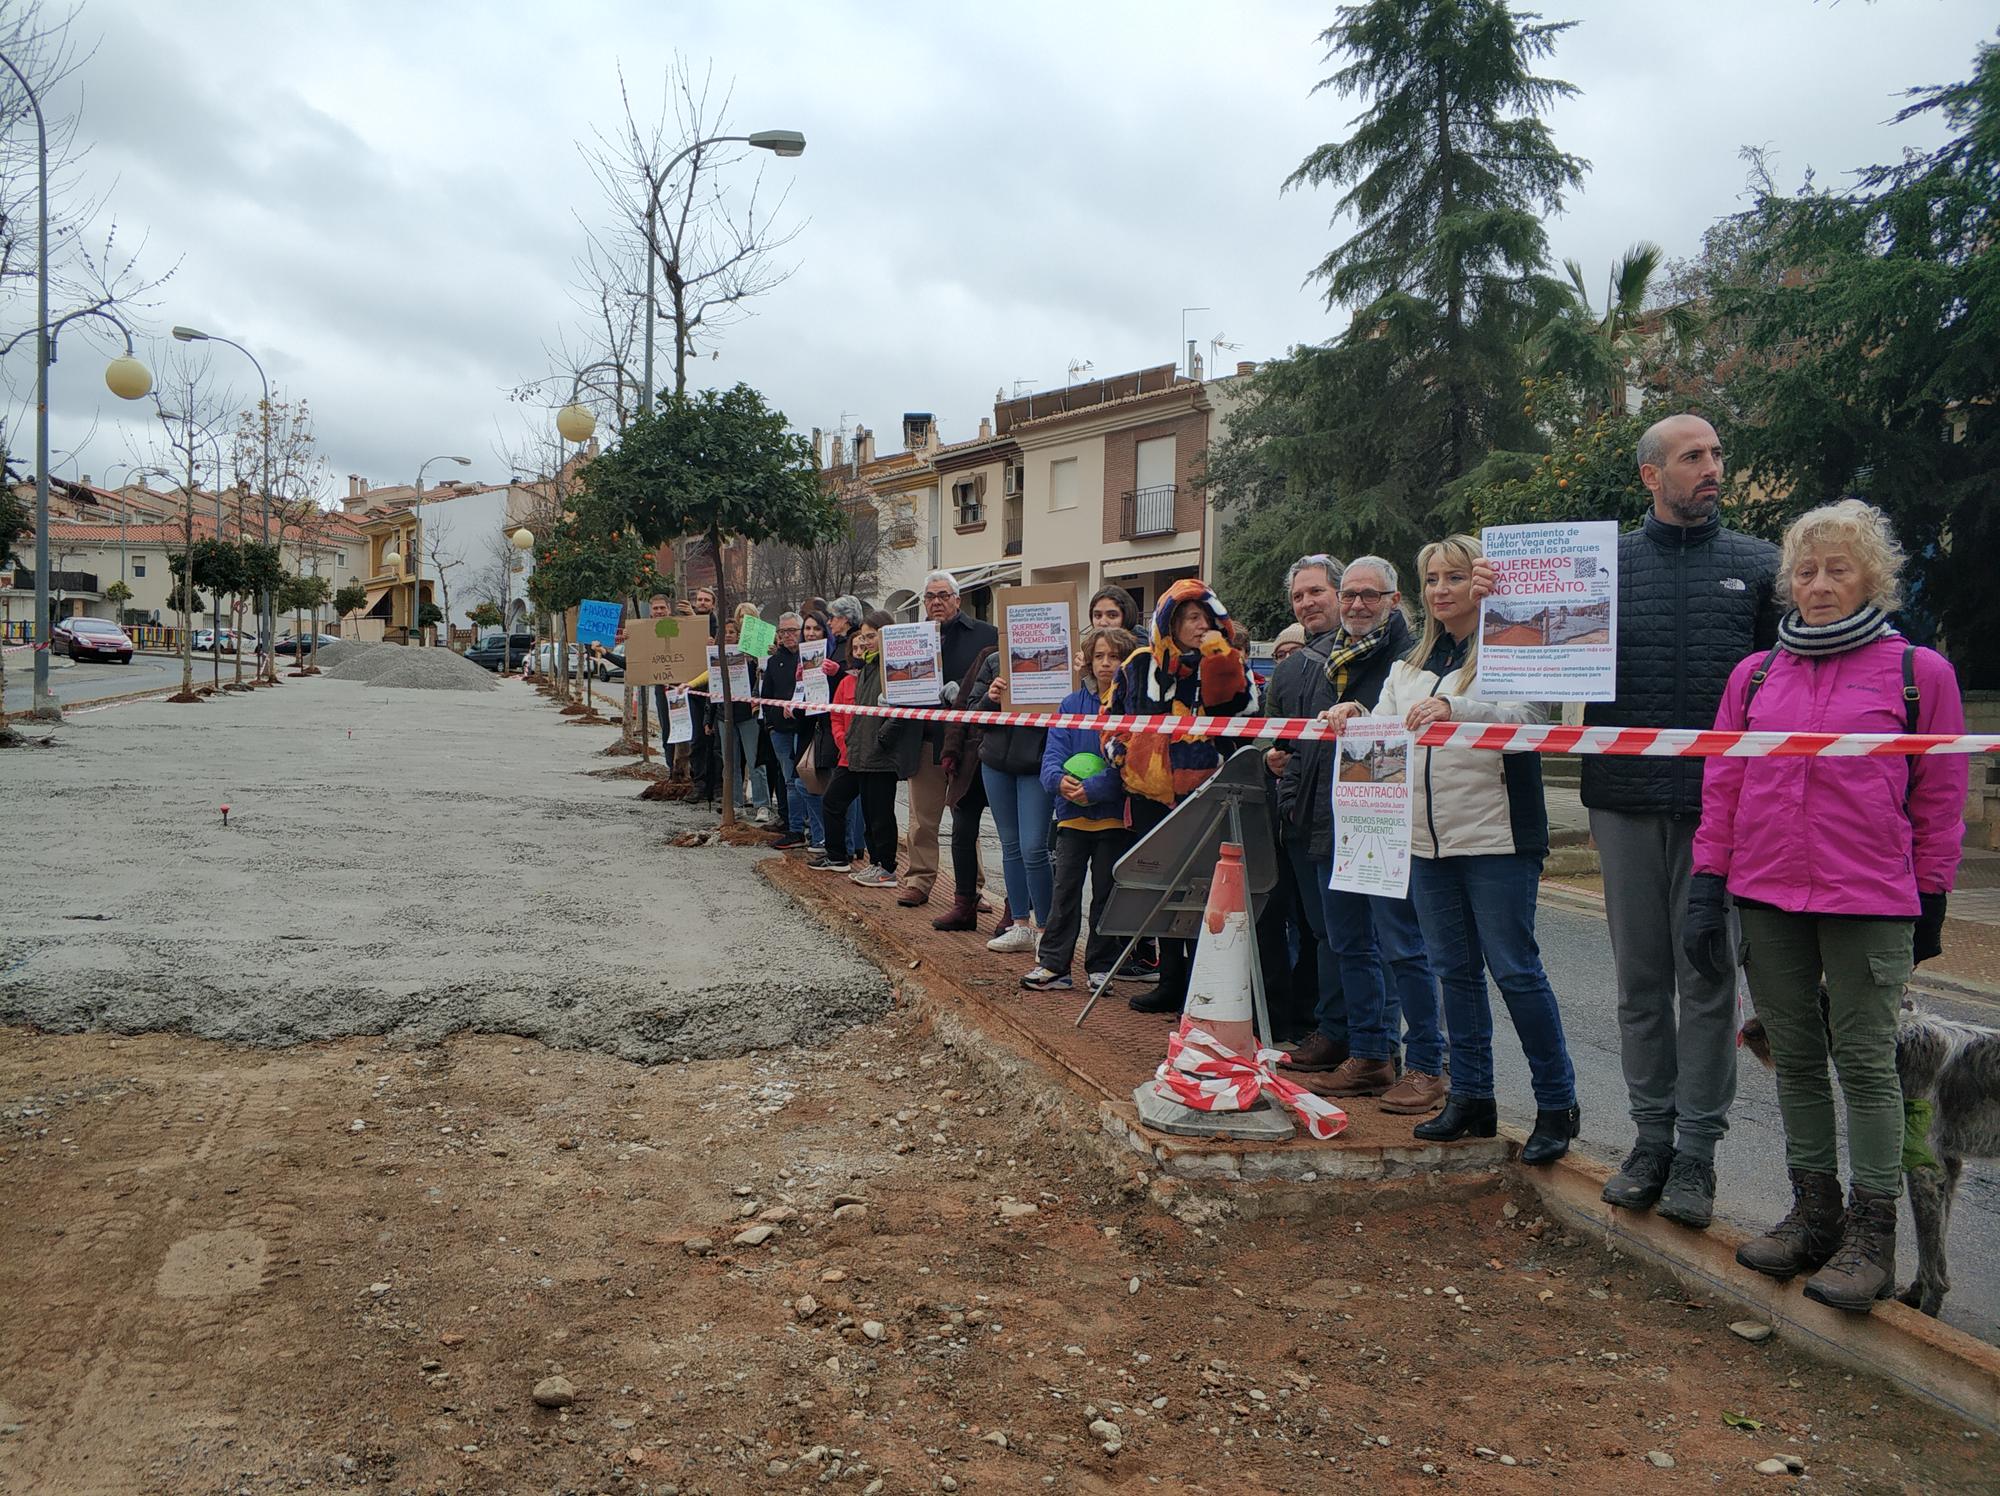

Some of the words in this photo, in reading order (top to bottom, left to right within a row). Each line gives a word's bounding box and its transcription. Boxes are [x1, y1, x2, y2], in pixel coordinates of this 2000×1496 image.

[1486, 533, 1496, 541] El
[1498, 529, 1564, 541] Ayuntamiento
[1567, 528, 1580, 536] de
[1486, 539, 1519, 549] Huétor
[1521, 538, 1544, 549] Vega
[1546, 537, 1570, 545] echa
[1486, 548, 1527, 558] cemento
[1530, 547, 1542, 555] en
[1544, 546, 1558, 554] los
[1561, 544, 1600, 555] parques
[1491, 557, 1572, 572] QUEREMOS
[1491, 584, 1511, 596] NO
[1515, 581, 1587, 596] CEMENTO.
[1011, 622, 1050, 631] QUEREMOS
[1336, 783, 1408, 799] CONCENTRACIÓN
[1341, 815, 1375, 825] QUEREMOS
[1353, 825, 1363, 833] NO
